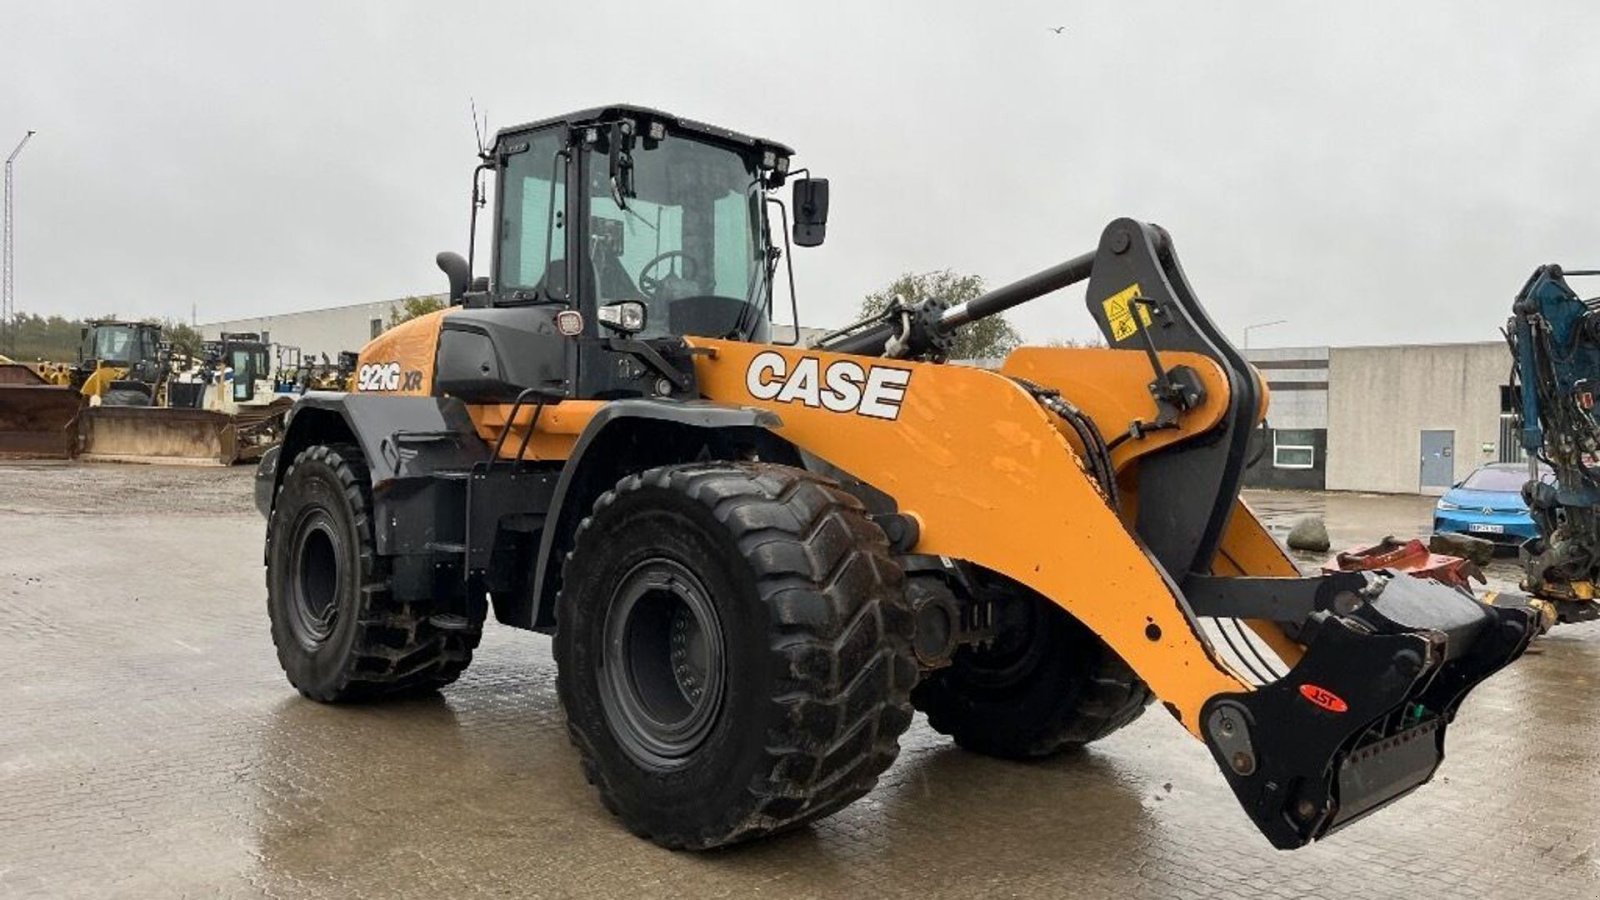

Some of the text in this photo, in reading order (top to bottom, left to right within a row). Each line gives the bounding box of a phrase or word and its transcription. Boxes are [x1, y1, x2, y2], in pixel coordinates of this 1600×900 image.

[358, 361, 423, 391] 921G XR
[746, 350, 912, 420] CASE
